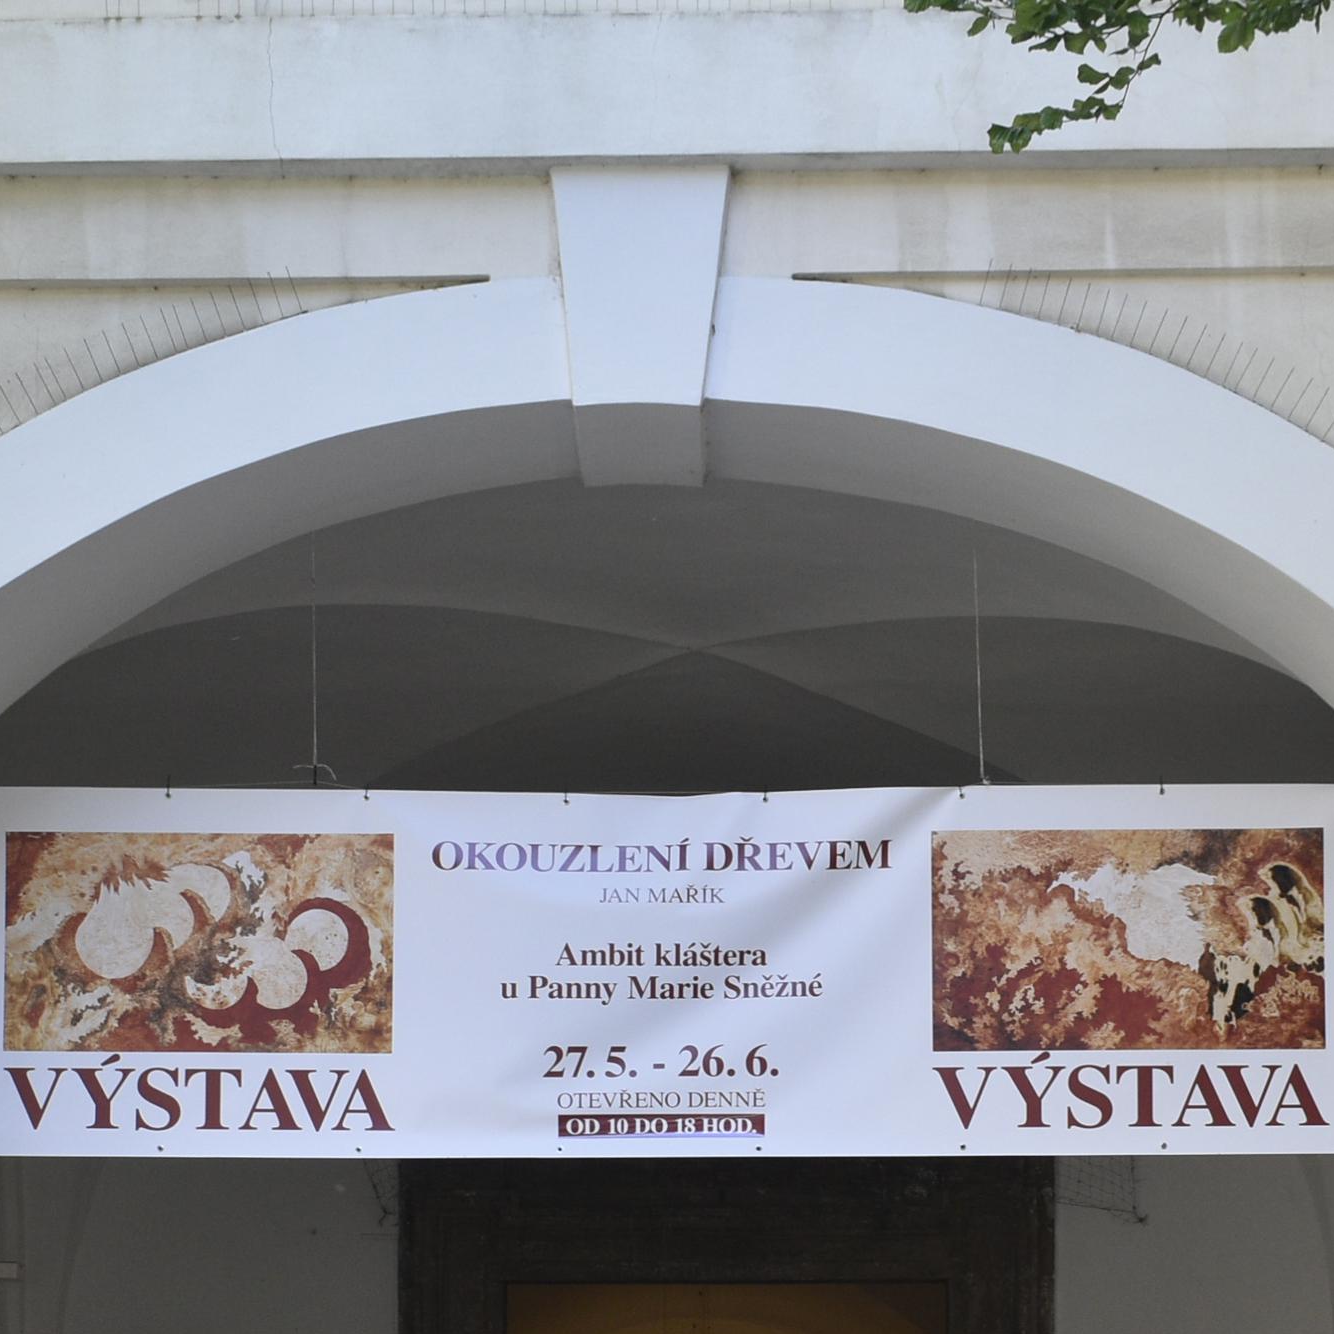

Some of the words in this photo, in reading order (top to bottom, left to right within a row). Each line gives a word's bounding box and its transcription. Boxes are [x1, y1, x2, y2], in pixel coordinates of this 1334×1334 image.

[431, 838, 690, 873] OKOUZLENÍ
[703, 837, 893, 872] DŘEVEM
[599, 887, 640, 904] JAN
[648, 884, 725, 904] MAŘÍK
[556, 943, 644, 967] Ambit
[655, 943, 767, 967] kláštera
[501, 983, 518, 999] u
[528, 975, 618, 1006] Panny
[628, 975, 714, 1000] Marie
[723, 973, 824, 999] Sněžné
[3, 1053, 396, 1131] VÝSTAVA
[557, 1089, 681, 1109] OTEVŘENO
[688, 1088, 766, 1109] DENNĚ
[932, 1051, 1330, 1129] VÝSTAVA
[566, 1118, 601, 1135] OD
[607, 1118, 628, 1135] 10
[634, 1118, 668, 1135] DO
[674, 1118, 696, 1134] 18
[702, 1118, 758, 1134] HOD.
